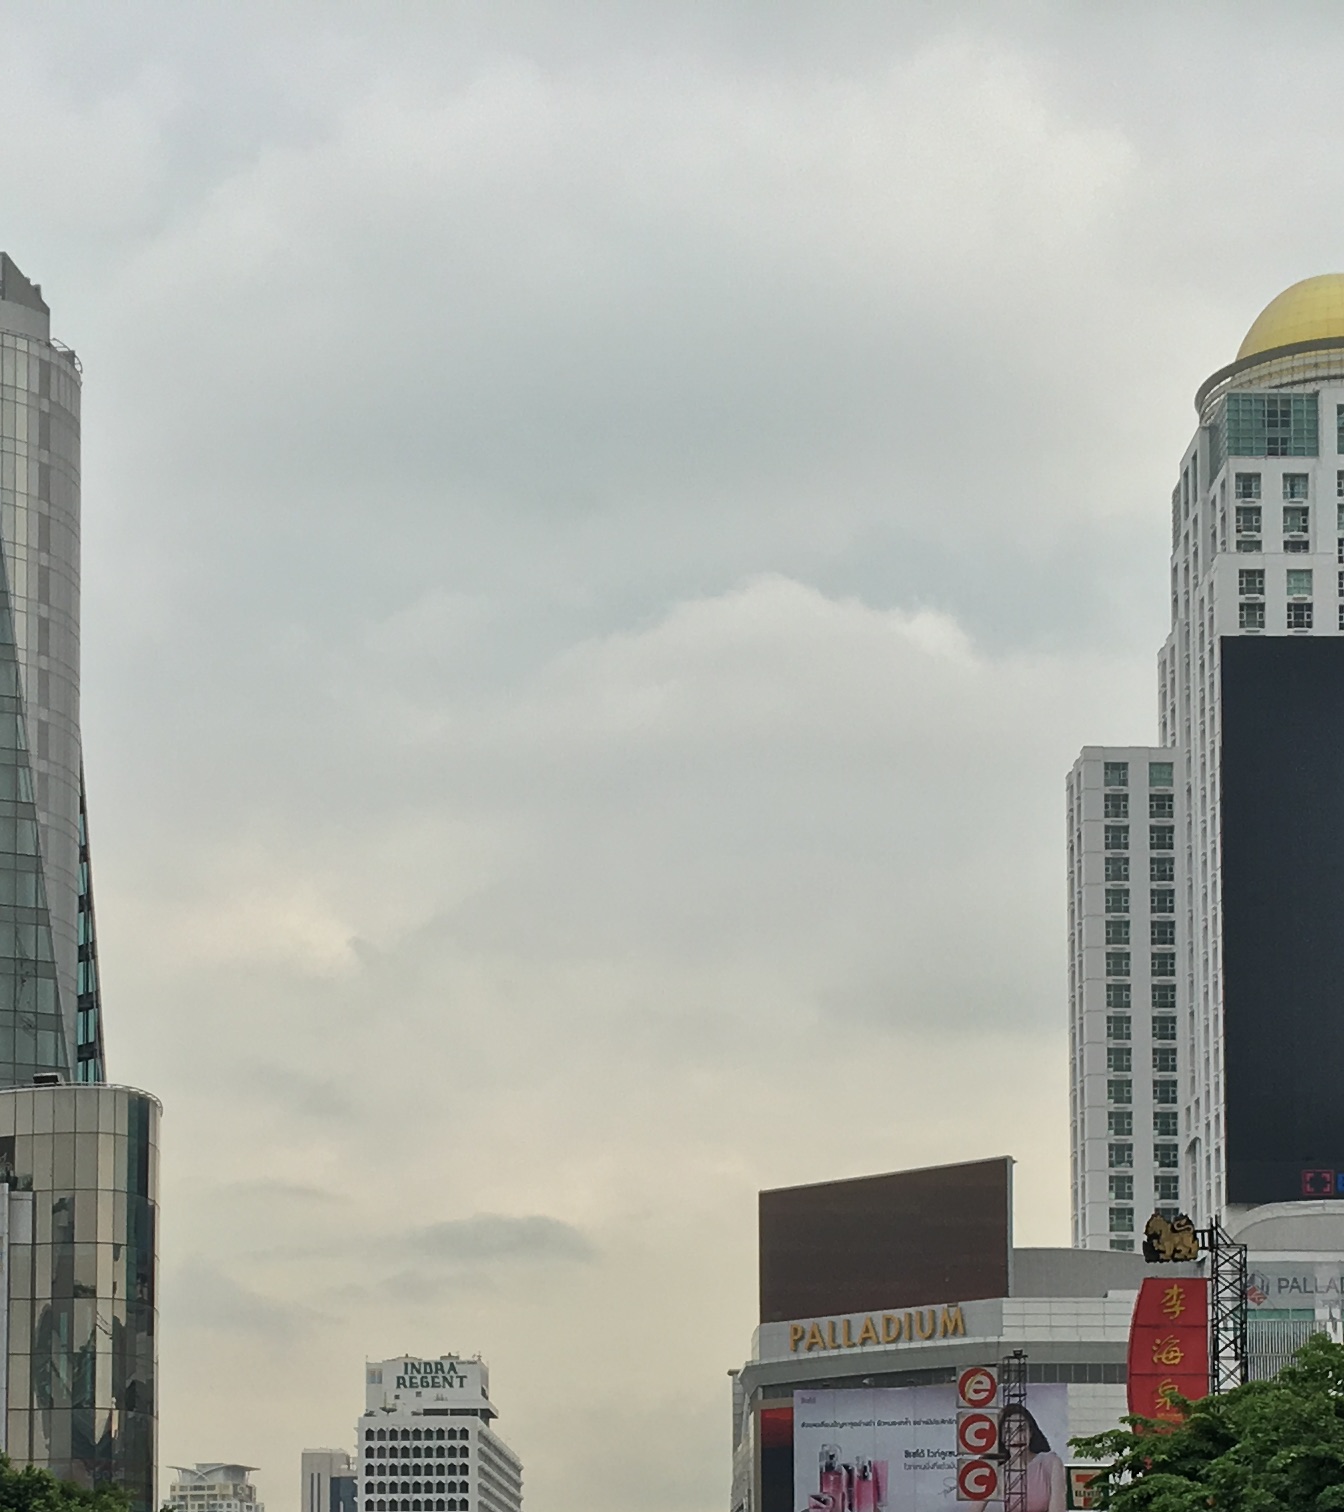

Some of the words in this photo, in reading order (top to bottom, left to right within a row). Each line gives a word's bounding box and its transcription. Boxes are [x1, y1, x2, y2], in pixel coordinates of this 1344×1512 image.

[788, 1306, 966, 1353] PALLADIUM
[403, 1361, 459, 1375] INDRA
[395, 1375, 468, 1389] REGENT
